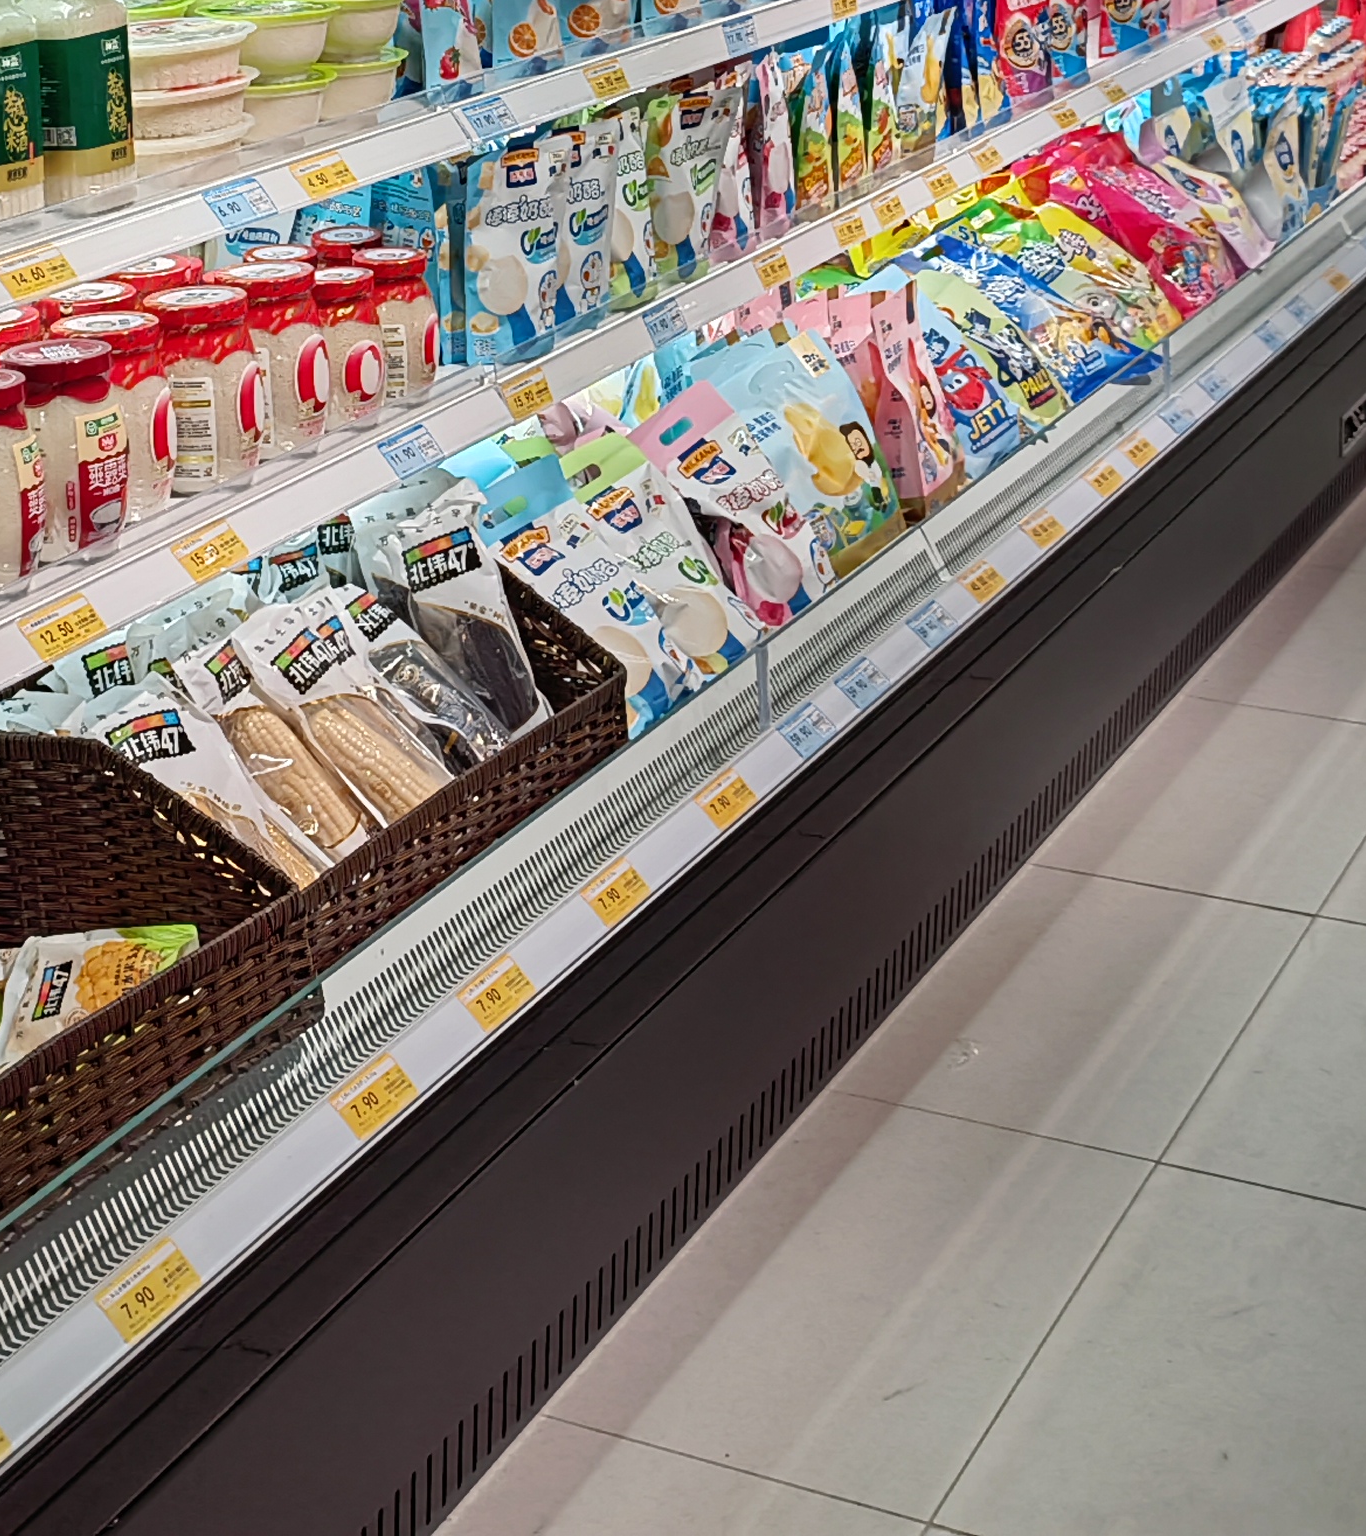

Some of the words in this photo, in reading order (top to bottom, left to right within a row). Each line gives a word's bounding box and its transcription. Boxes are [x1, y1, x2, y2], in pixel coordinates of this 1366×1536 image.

[474, 114, 495, 130] 17.90
[307, 172, 329, 188] 4.50
[217, 201, 242, 218] 6.90
[11, 266, 46, 286] 14.60
[514, 389, 536, 407] 15.90
[969, 401, 1008, 441] JETT
[390, 446, 417, 465] 11.90
[410, 541, 474, 585] 北纬47°
[40, 620, 75, 644] 12.50
[120, 724, 184, 762] 北纬47°
[710, 795, 730, 815] 7.90
[598, 888, 620, 911] 7.90
[476, 988, 502, 1013] 7.90
[350, 1091, 379, 1119] 7.90
[121, 1286, 155, 1320] 7.90
